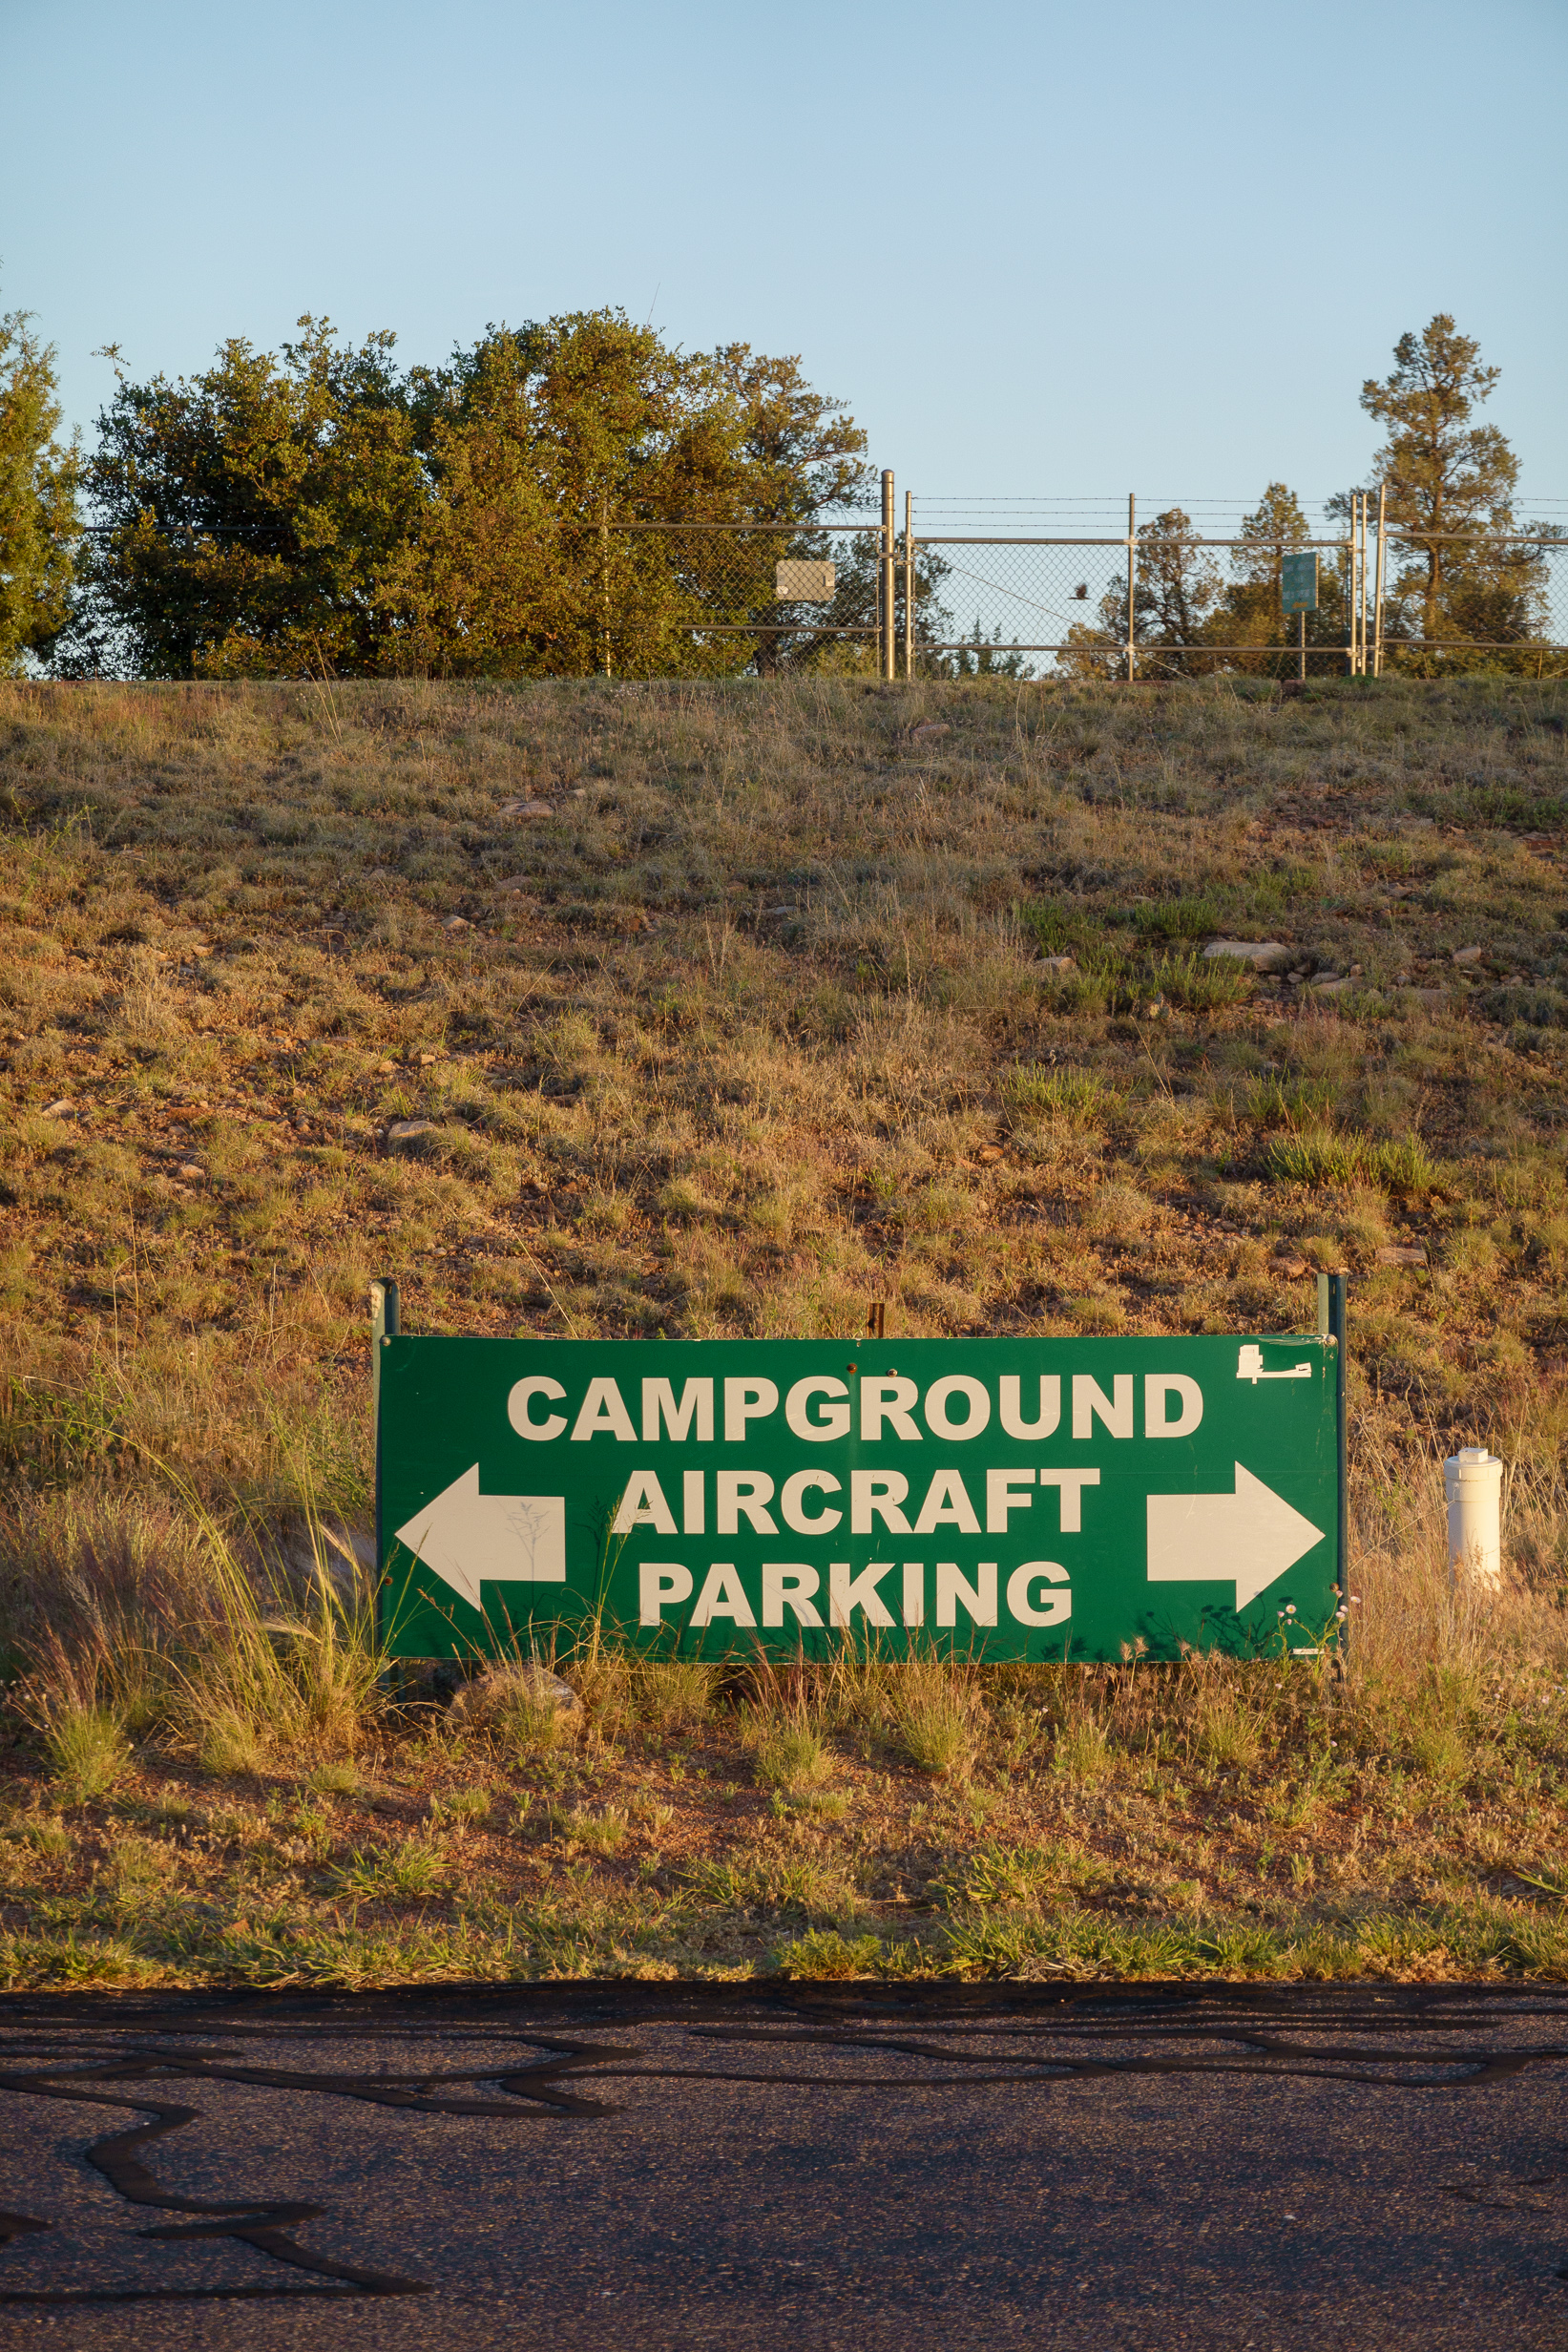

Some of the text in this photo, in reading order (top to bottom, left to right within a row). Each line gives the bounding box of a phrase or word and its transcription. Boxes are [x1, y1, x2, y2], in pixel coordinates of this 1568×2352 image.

[508, 1374, 1204, 1442] CAMPGROUND
[611, 1468, 1101, 1535] AIRCRAFT
[638, 1562, 1072, 1628] PARKING
